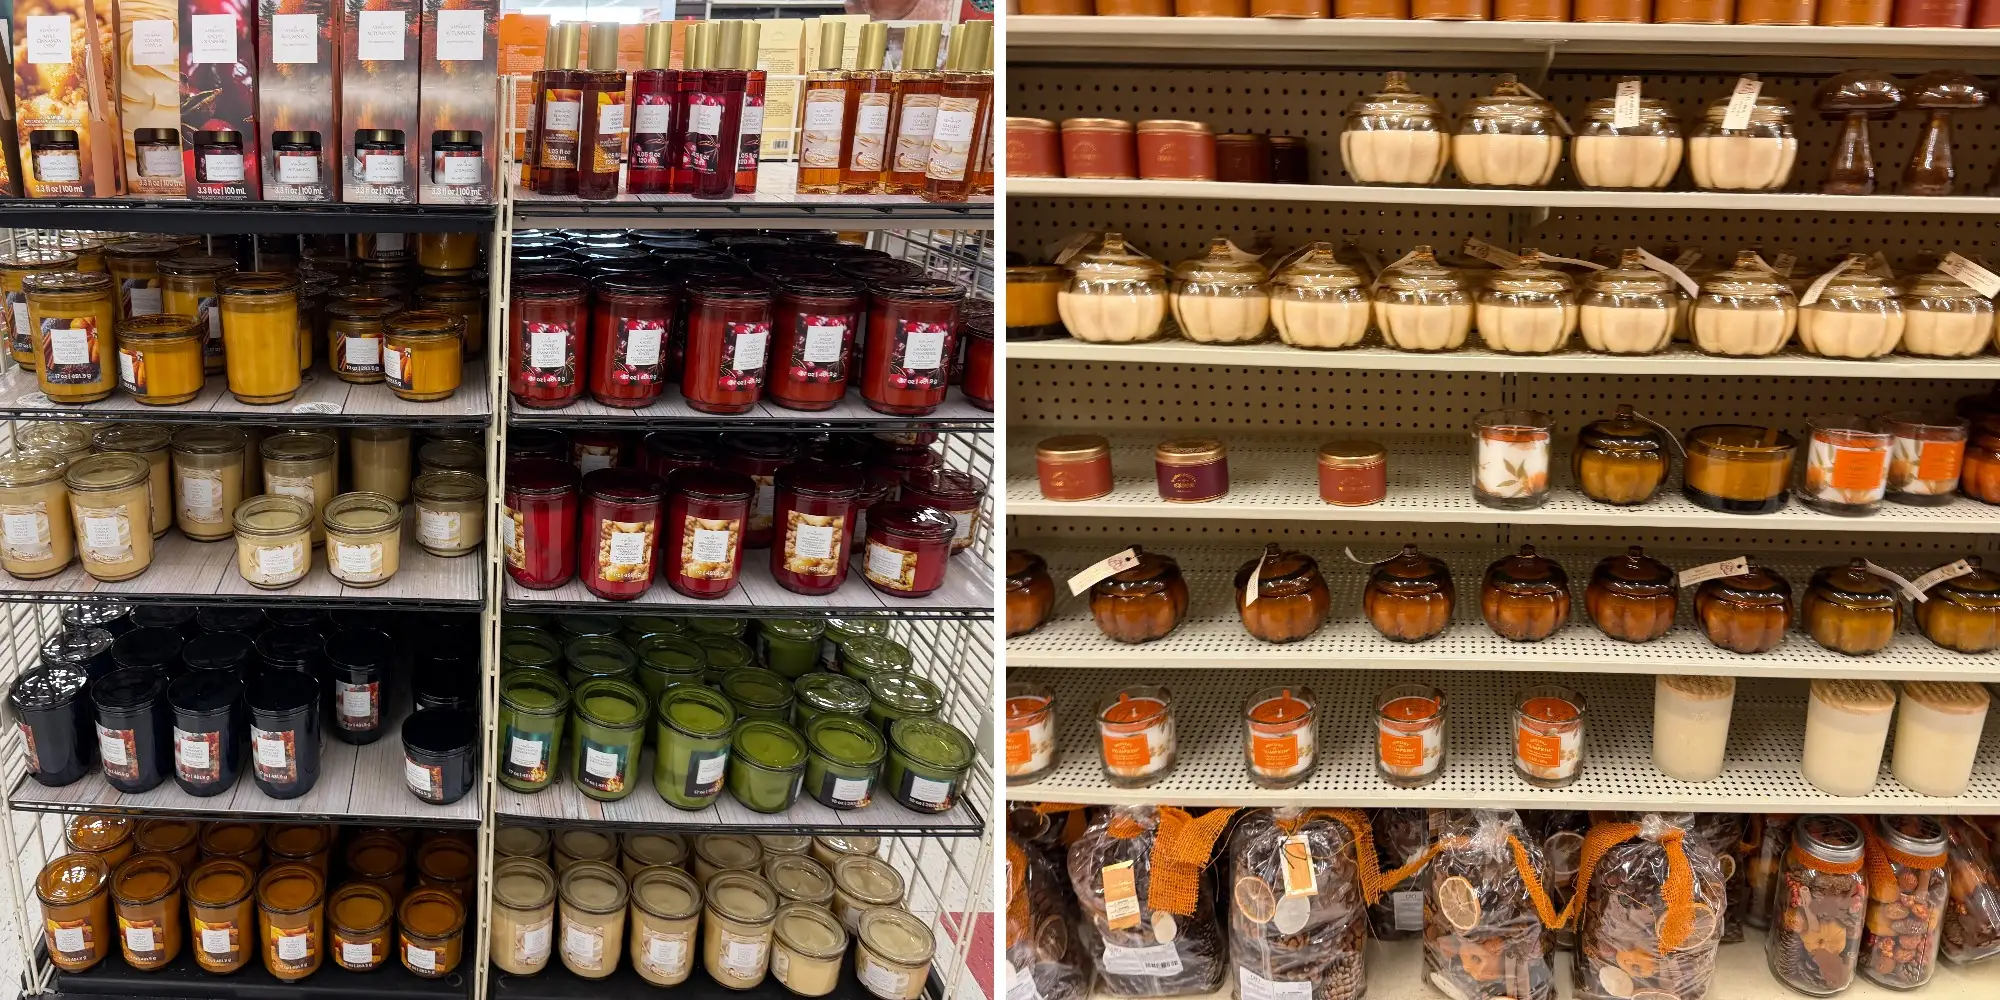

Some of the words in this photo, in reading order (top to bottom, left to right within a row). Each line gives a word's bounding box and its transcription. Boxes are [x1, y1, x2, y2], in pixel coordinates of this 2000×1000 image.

[198, 186, 207, 194] 3.3
[208, 186, 212, 194] fl
[224, 187, 235, 195] 100
[236, 187, 246, 195] mL
[1527, 743, 1551, 752] PUMPKIN
